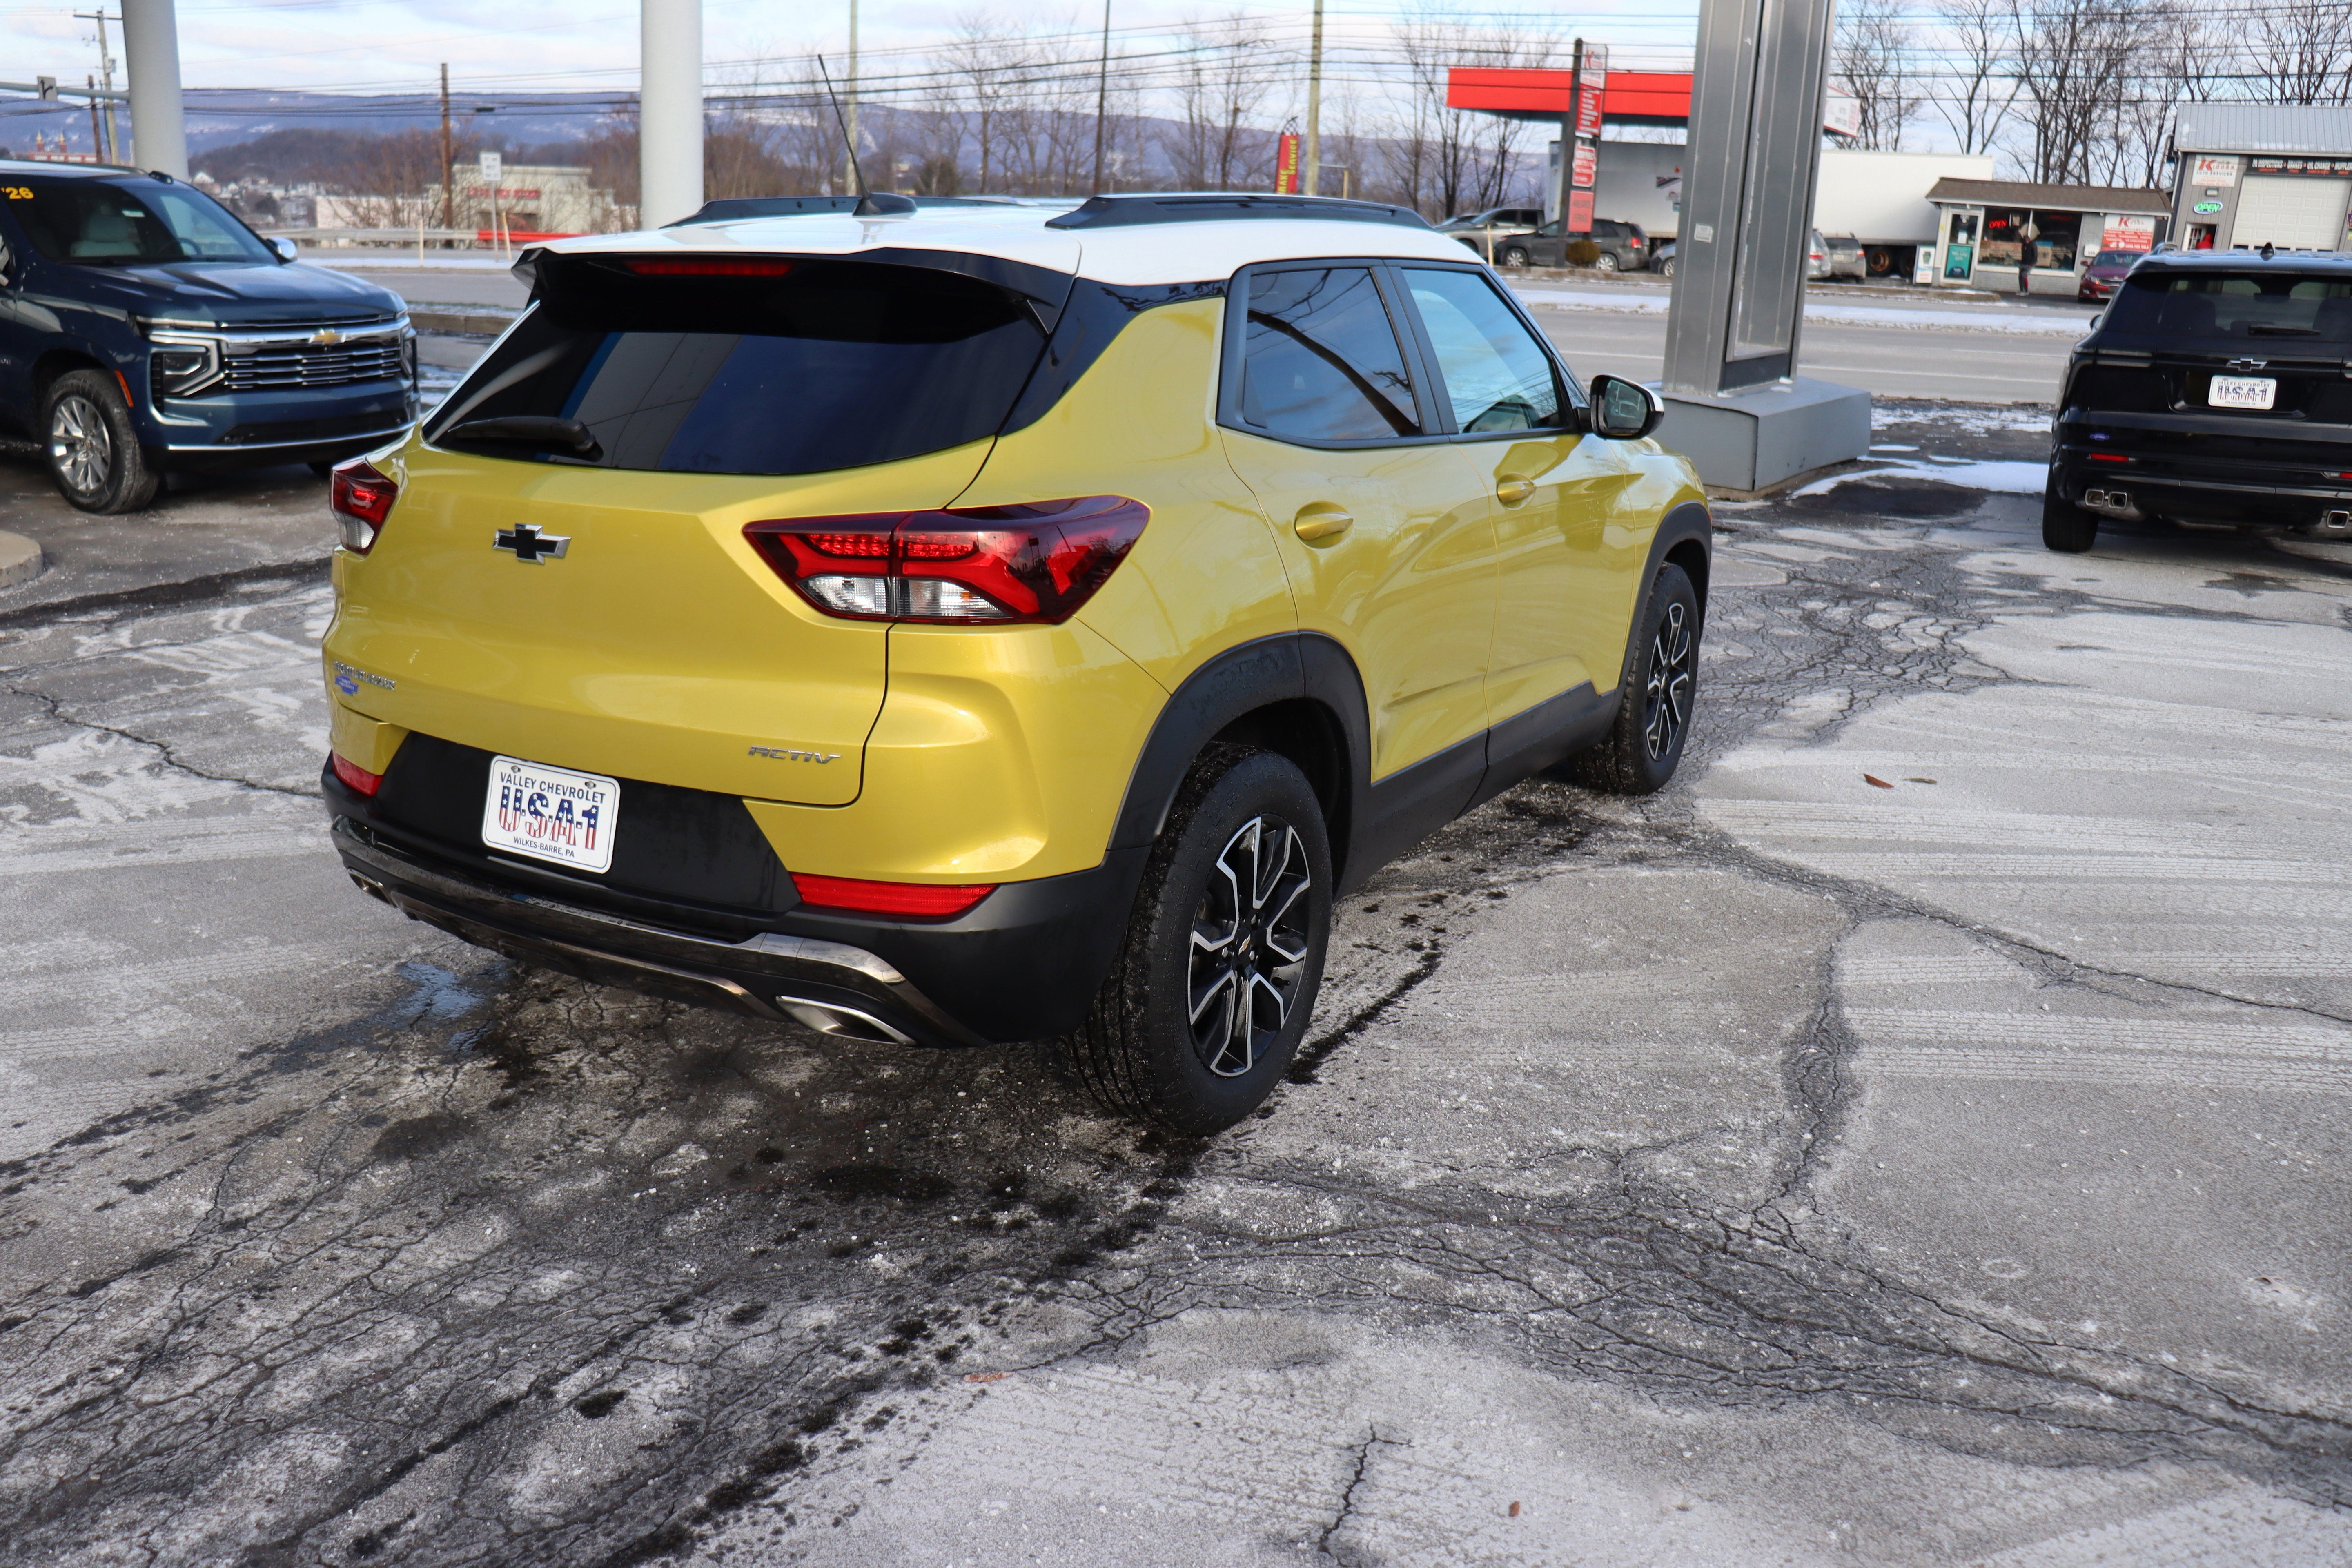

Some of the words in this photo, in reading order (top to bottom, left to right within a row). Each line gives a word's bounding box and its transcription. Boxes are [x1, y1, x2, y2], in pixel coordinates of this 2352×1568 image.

[1287, 139, 1297, 175] SERVICE
[2196, 203, 2220, 212] OPEN
[1989, 220, 2007, 229] OPEN
[748, 745, 842, 764] ACTIV
[501, 772, 537, 789] VALLEY
[540, 781, 606, 804] CHEVROLET
[514, 837, 564, 856] WILKES-BARRE,
[566, 849, 575, 858] PA
